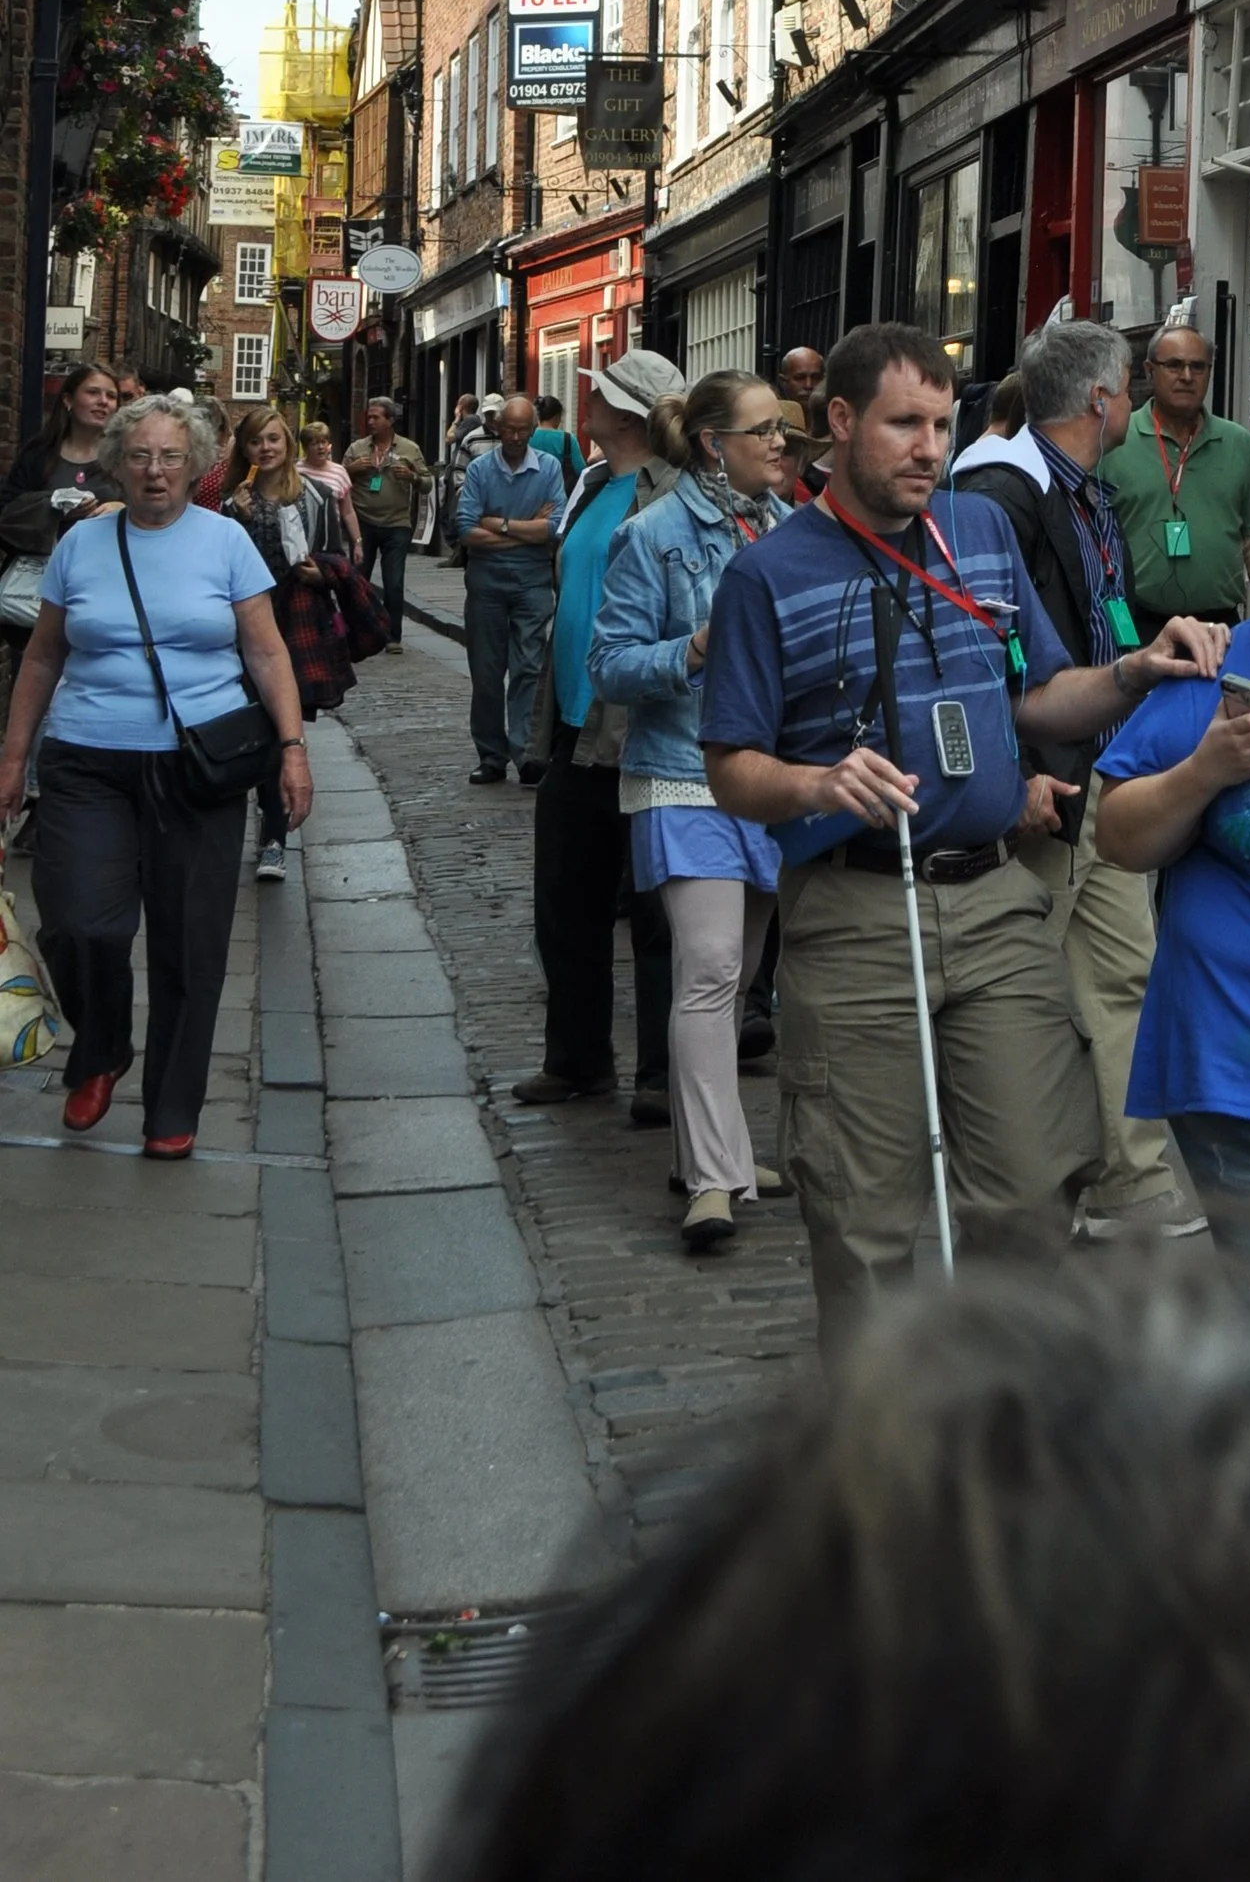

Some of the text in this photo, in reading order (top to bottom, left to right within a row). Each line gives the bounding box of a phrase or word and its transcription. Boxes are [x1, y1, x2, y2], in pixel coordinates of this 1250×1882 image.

[521, 43, 586, 64] Blacks
[605, 68, 641, 82] THE
[509, 84, 547, 98] 01904
[604, 98, 643, 112] GIFT
[584, 127, 661, 142] GALLERY
[213, 187, 242, 195] 01937
[316, 284, 355, 308] bari
